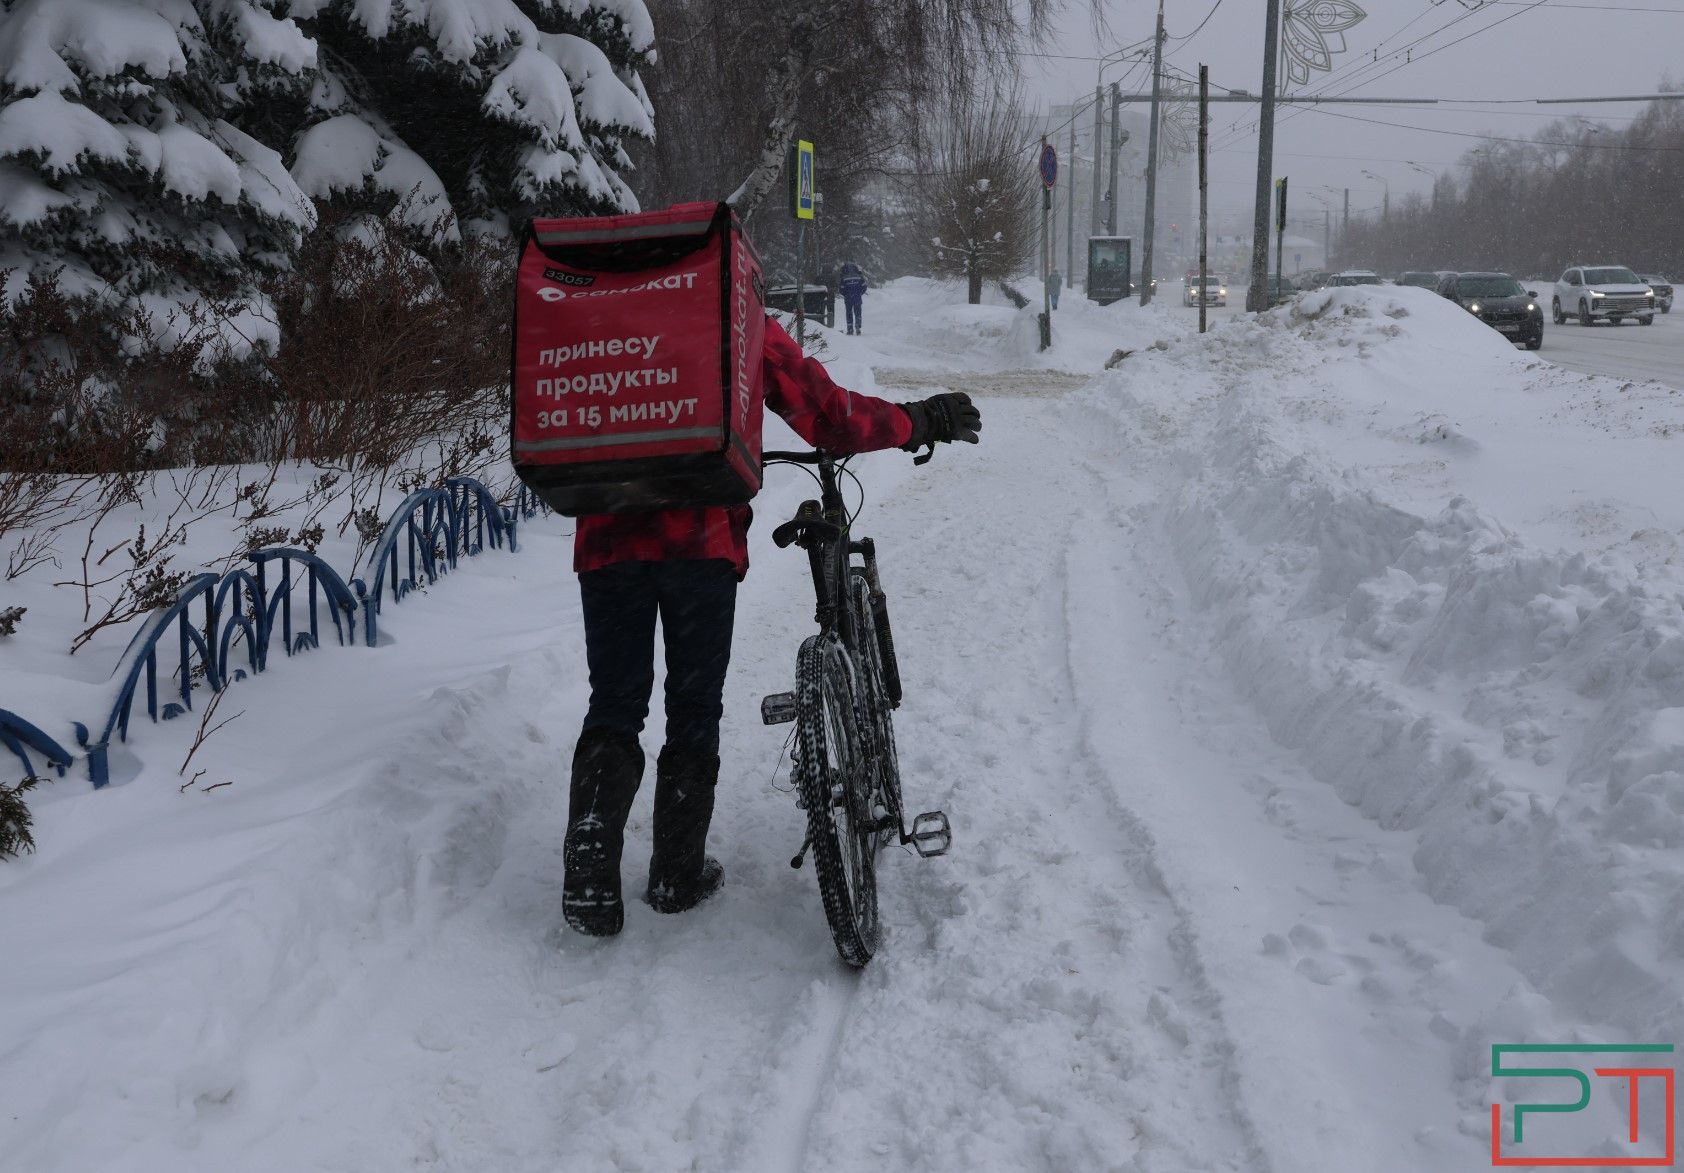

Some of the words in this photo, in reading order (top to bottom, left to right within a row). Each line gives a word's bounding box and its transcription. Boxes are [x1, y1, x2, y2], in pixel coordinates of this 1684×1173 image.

[545, 269, 593, 286] 33057
[570, 272, 698, 298] самокат
[539, 335, 660, 368] принесу
[734, 238, 749, 433] samokat.ru
[536, 366, 678, 400] продукты
[537, 408, 568, 429] за
[576, 406, 601, 429] 15
[609, 398, 698, 424] минут
